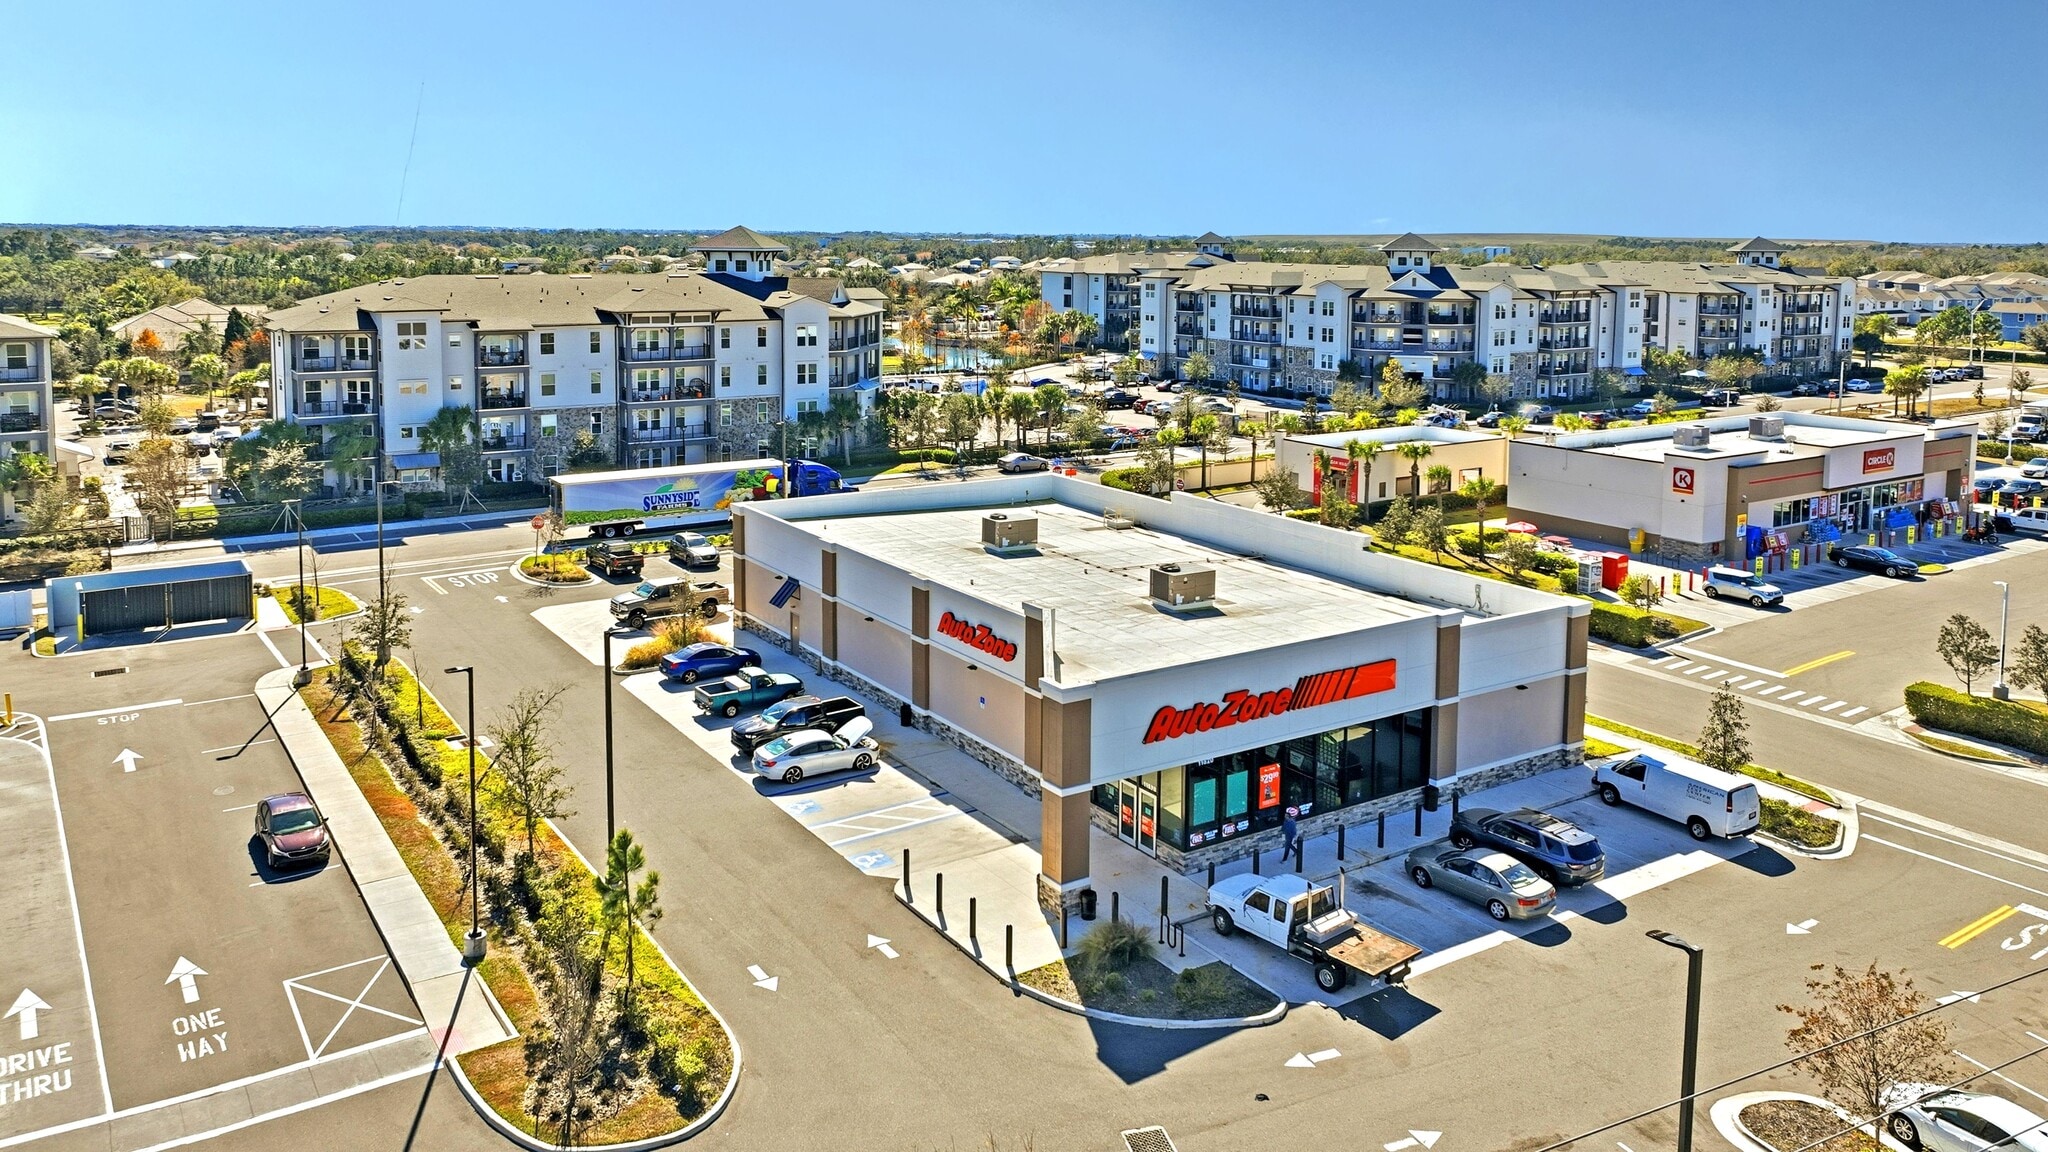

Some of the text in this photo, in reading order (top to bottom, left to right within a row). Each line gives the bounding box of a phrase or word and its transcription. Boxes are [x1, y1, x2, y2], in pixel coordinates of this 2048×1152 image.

[1867, 456, 1887, 465] CIRCLE
[1679, 474, 1689, 487] K
[643, 490, 701, 512] SUNNYSIDE
[448, 572, 499, 588] STOP
[937, 611, 1018, 662] AutoZone
[97, 712, 140, 725] STOP
[1143, 687, 1293, 745] AutoZone
[1686, 789, 1711, 800] CENTER
[1688, 782, 1725, 798] AMERICAN
[2000, 923, 2048, 960] S
[172, 1007, 226, 1036] ONE
[177, 1031, 229, 1063] WAY
[0, 1068, 72, 1106] THRU
